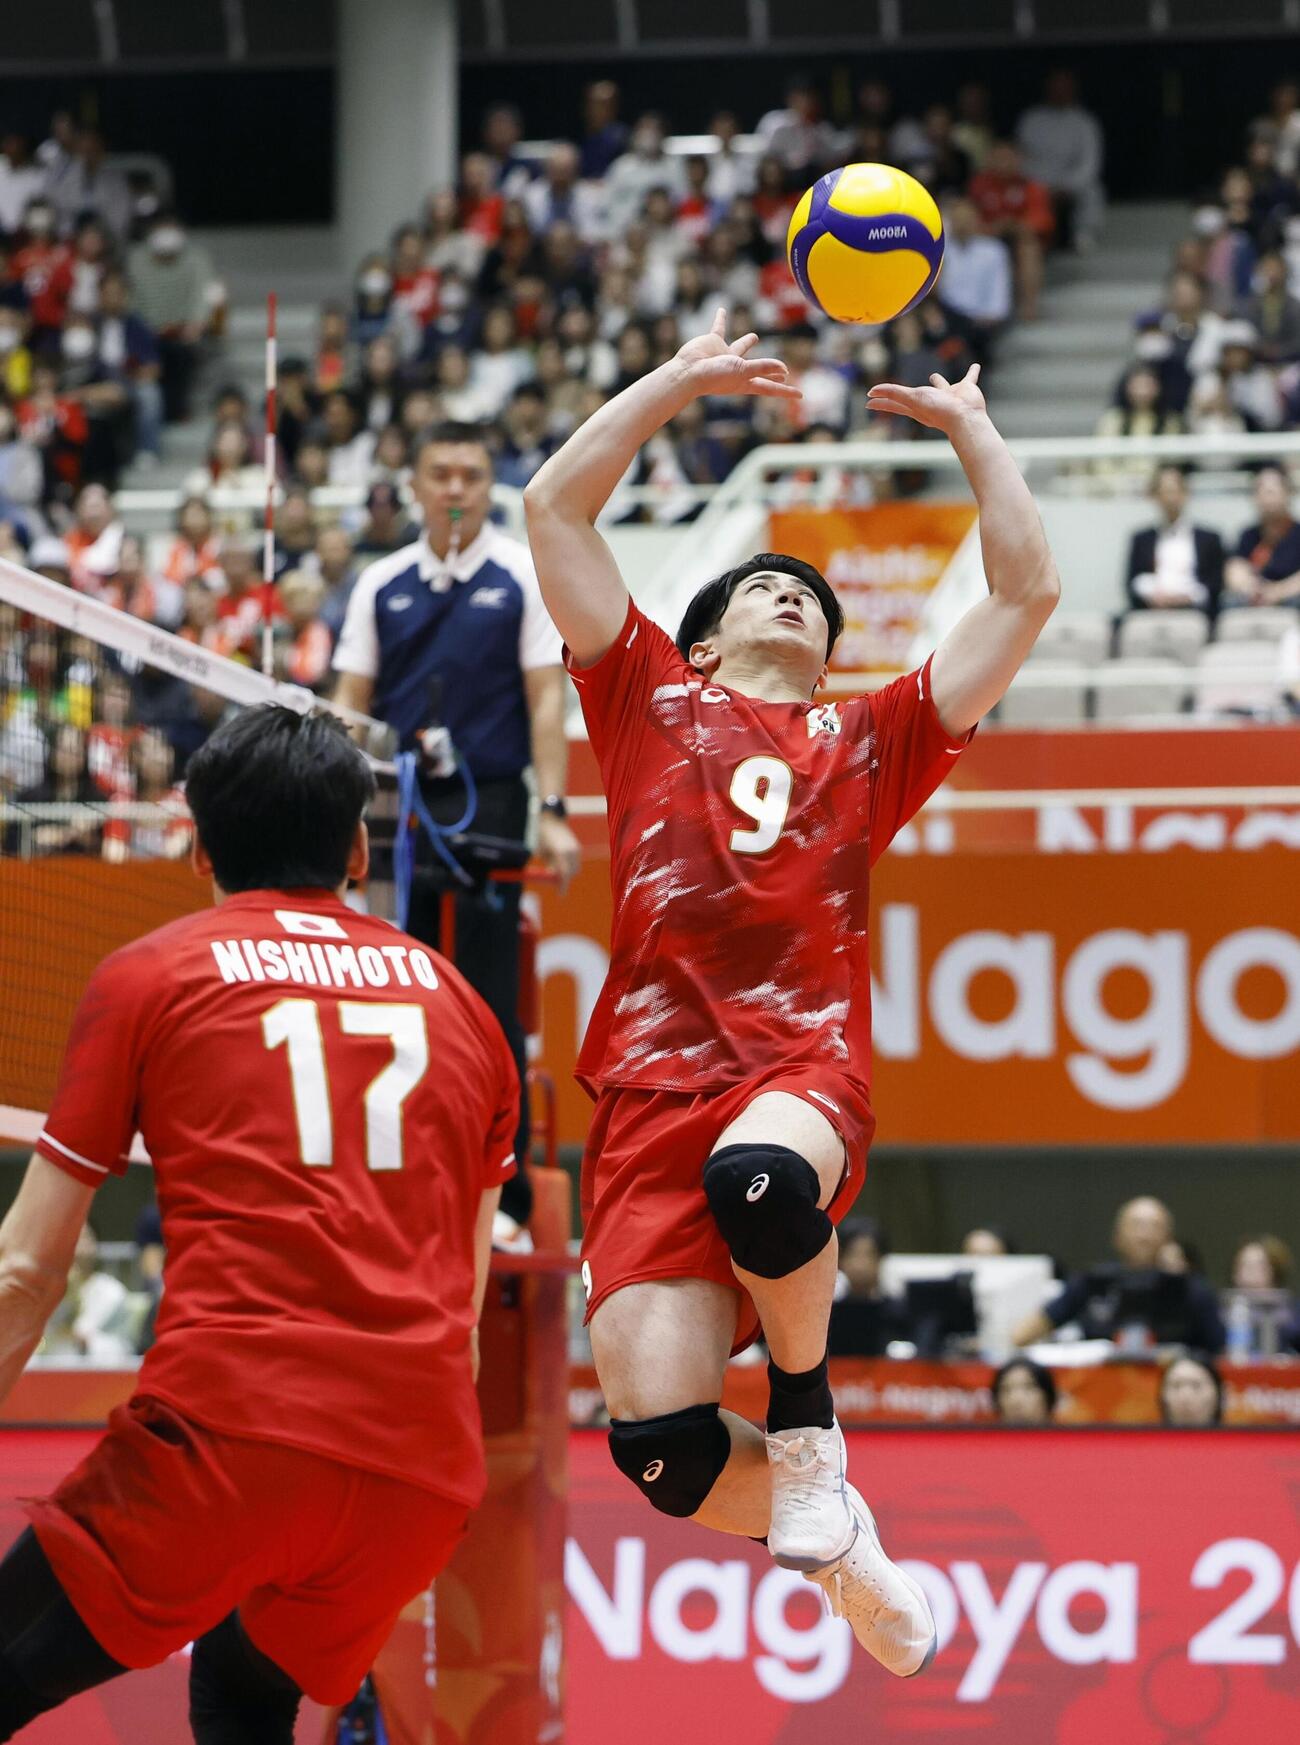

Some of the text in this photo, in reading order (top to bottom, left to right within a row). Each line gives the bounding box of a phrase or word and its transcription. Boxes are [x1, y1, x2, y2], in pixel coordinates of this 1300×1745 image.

[729, 755, 794, 853] 9
[210, 938, 439, 991] NISHIMOTO
[260, 996, 429, 1172] 17
[1187, 1537, 1300, 1665] 2
